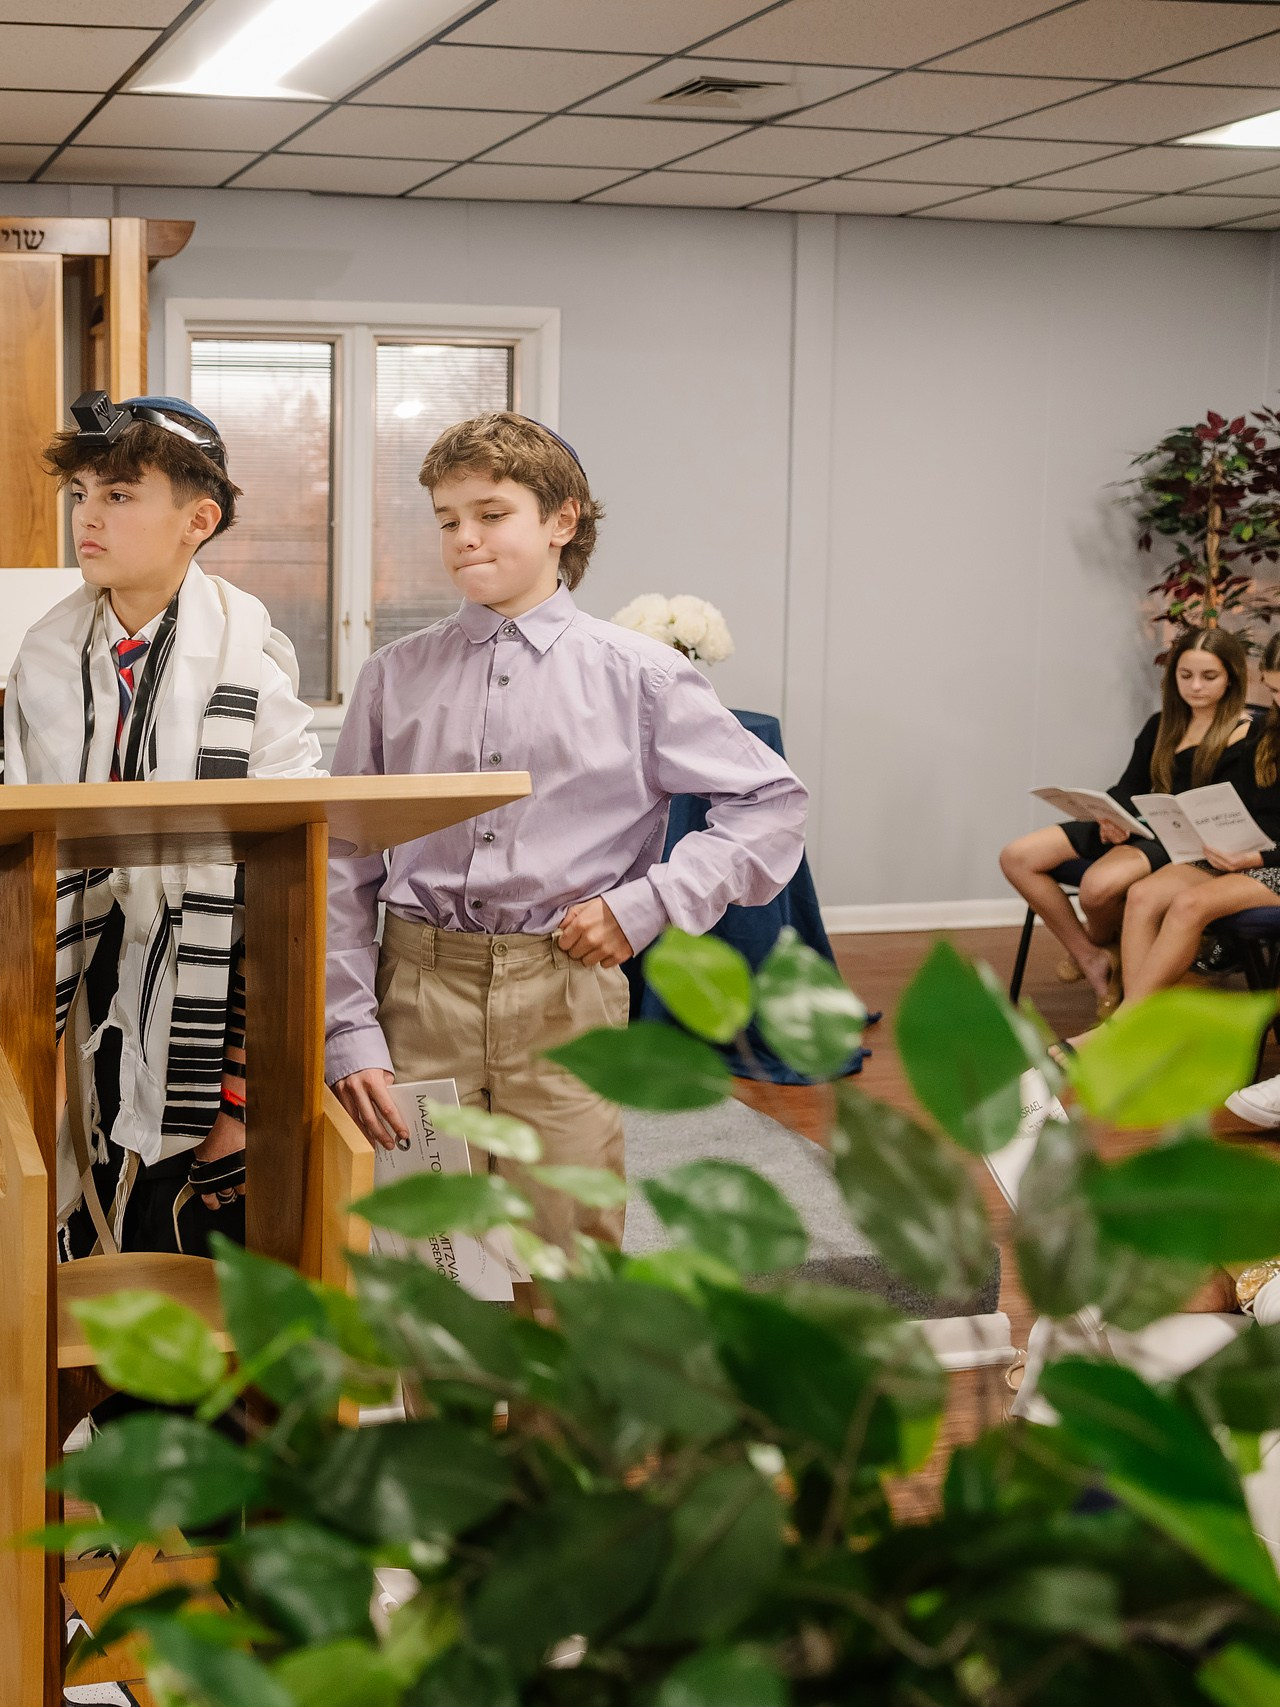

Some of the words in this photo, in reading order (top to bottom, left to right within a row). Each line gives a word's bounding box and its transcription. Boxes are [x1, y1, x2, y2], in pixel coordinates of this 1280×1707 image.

[1020, 1100, 1044, 1119] SRAEL
[415, 1094, 437, 1148] MAZAL
[429, 1151, 443, 1174] TO
[428, 1235, 447, 1277] EREMO
